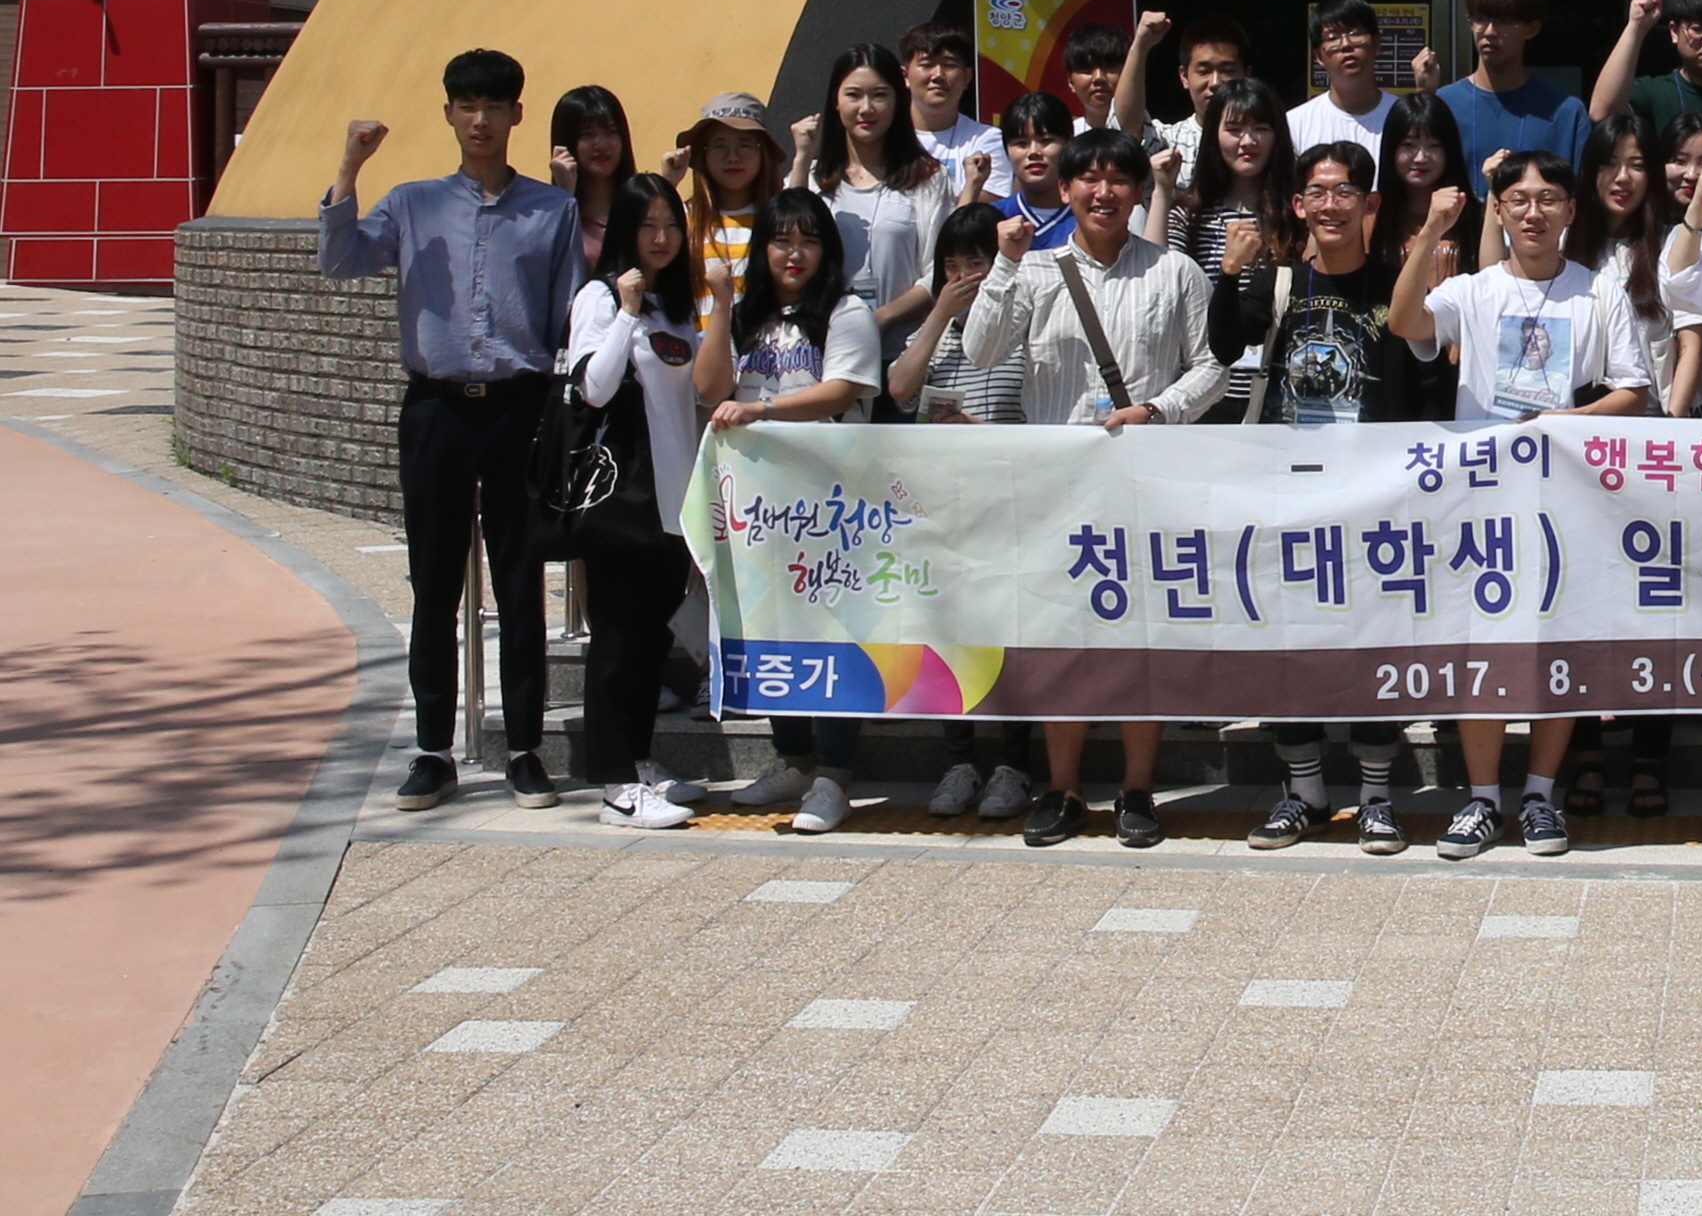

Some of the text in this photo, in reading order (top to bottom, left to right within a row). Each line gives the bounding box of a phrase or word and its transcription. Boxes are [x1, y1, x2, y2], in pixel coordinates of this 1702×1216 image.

[989, 11, 1026, 27] 청양군
[1405, 432, 1552, 494] 청년이
[826, 483, 912, 552] 청양
[787, 548, 939, 604] 행복한 군민
[725, 653, 839, 699] 구증가
